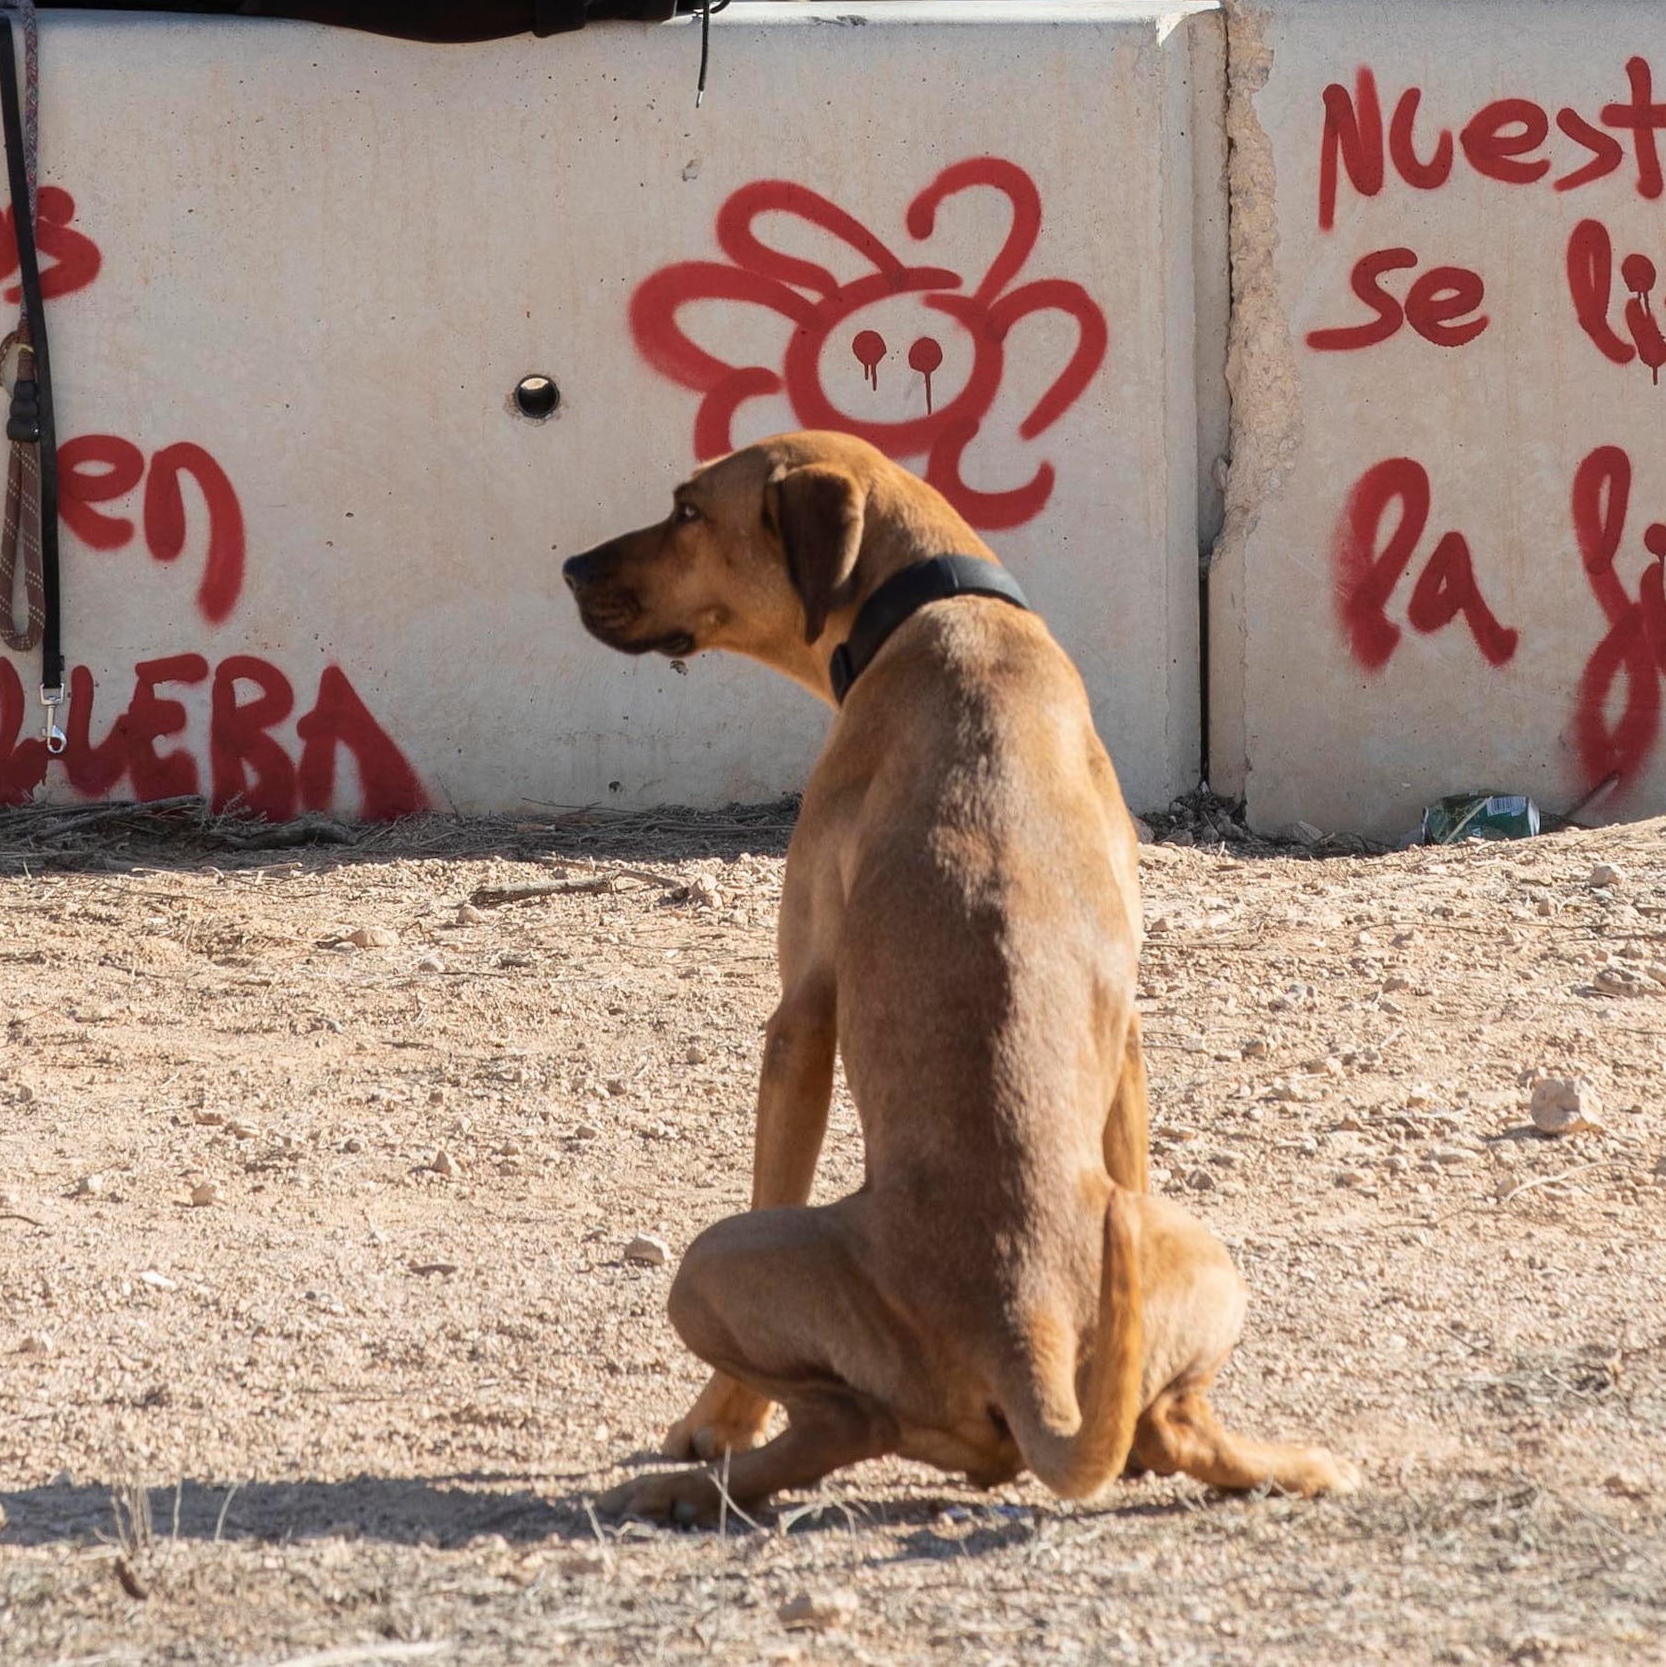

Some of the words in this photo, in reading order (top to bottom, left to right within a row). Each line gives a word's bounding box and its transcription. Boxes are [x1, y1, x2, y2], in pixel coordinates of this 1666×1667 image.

[1304, 247, 1489, 352] se
[55, 434, 247, 626] en
[1332, 456, 1518, 672] la
